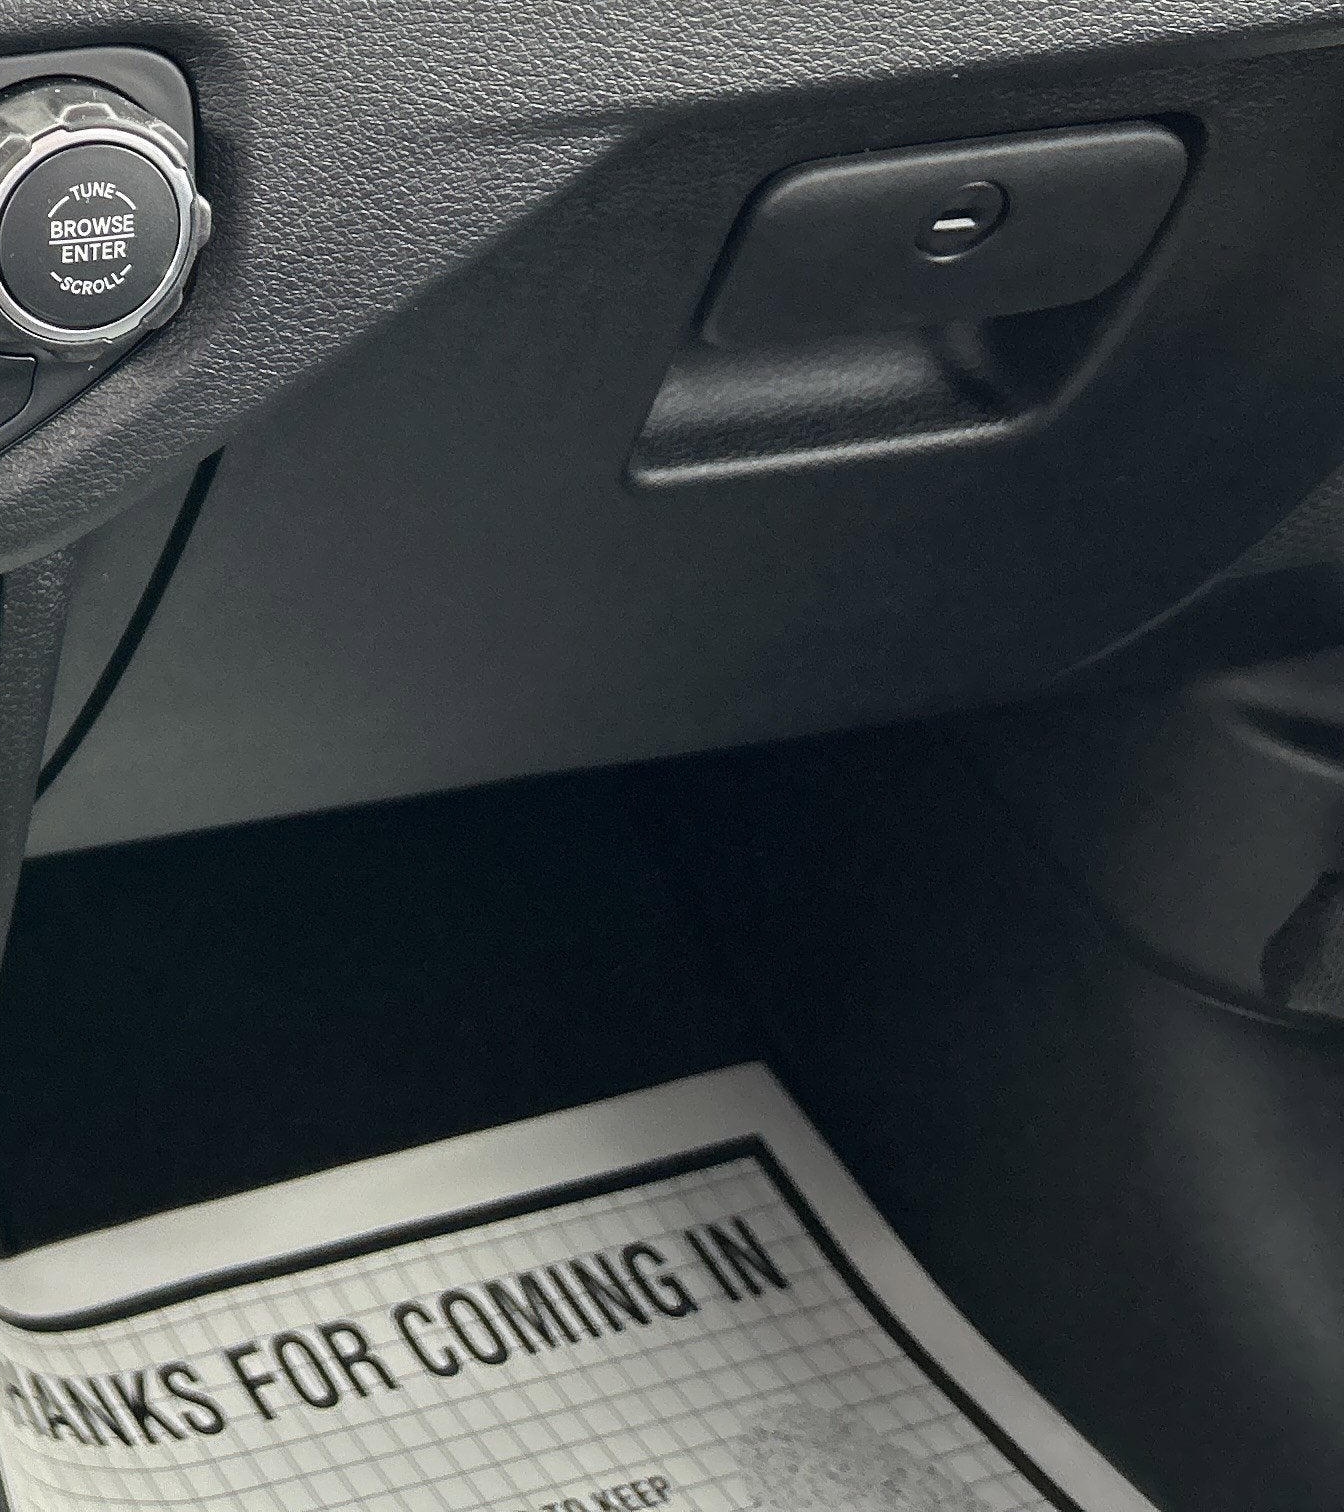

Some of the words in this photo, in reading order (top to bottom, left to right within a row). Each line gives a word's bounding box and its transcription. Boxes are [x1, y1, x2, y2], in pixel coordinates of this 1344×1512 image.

[69, 181, 116, 201] TUNE
[50, 213, 135, 238] BROWSE
[61, 240, 127, 264] ENTER
[59, 272, 125, 295] SCROLL
[2, 1358, 226, 1447] HANKS
[223, 1318, 400, 1422] FOR
[395, 1243, 690, 1381] COMING
[684, 1213, 789, 1297] IN
